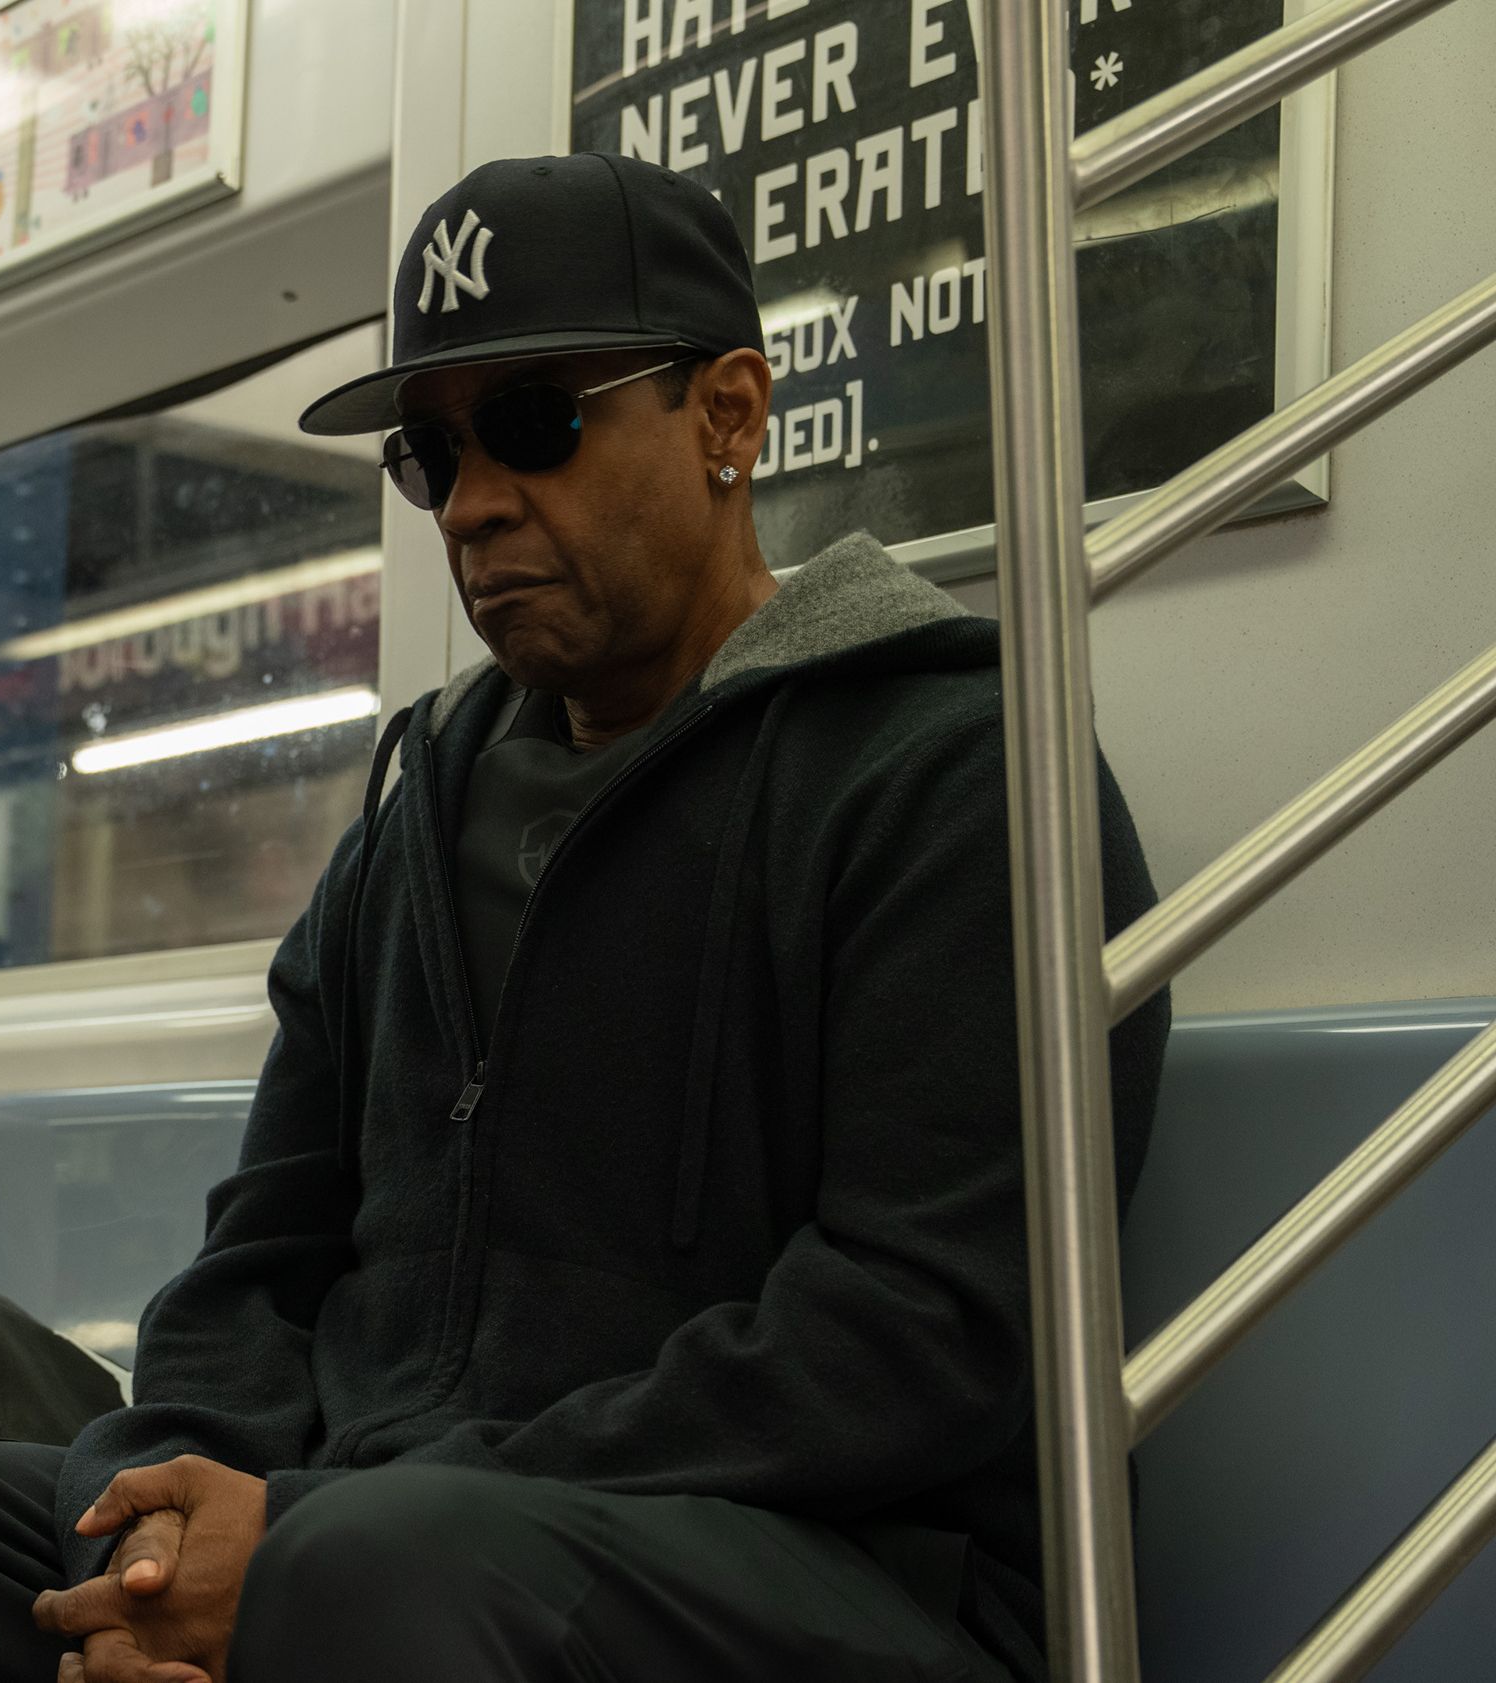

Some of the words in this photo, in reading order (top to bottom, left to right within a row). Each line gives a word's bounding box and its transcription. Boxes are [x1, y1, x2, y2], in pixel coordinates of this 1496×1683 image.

[620, 21, 858, 174] NEVER
[417, 209, 494, 314] NY
[890, 256, 987, 348] NOT
